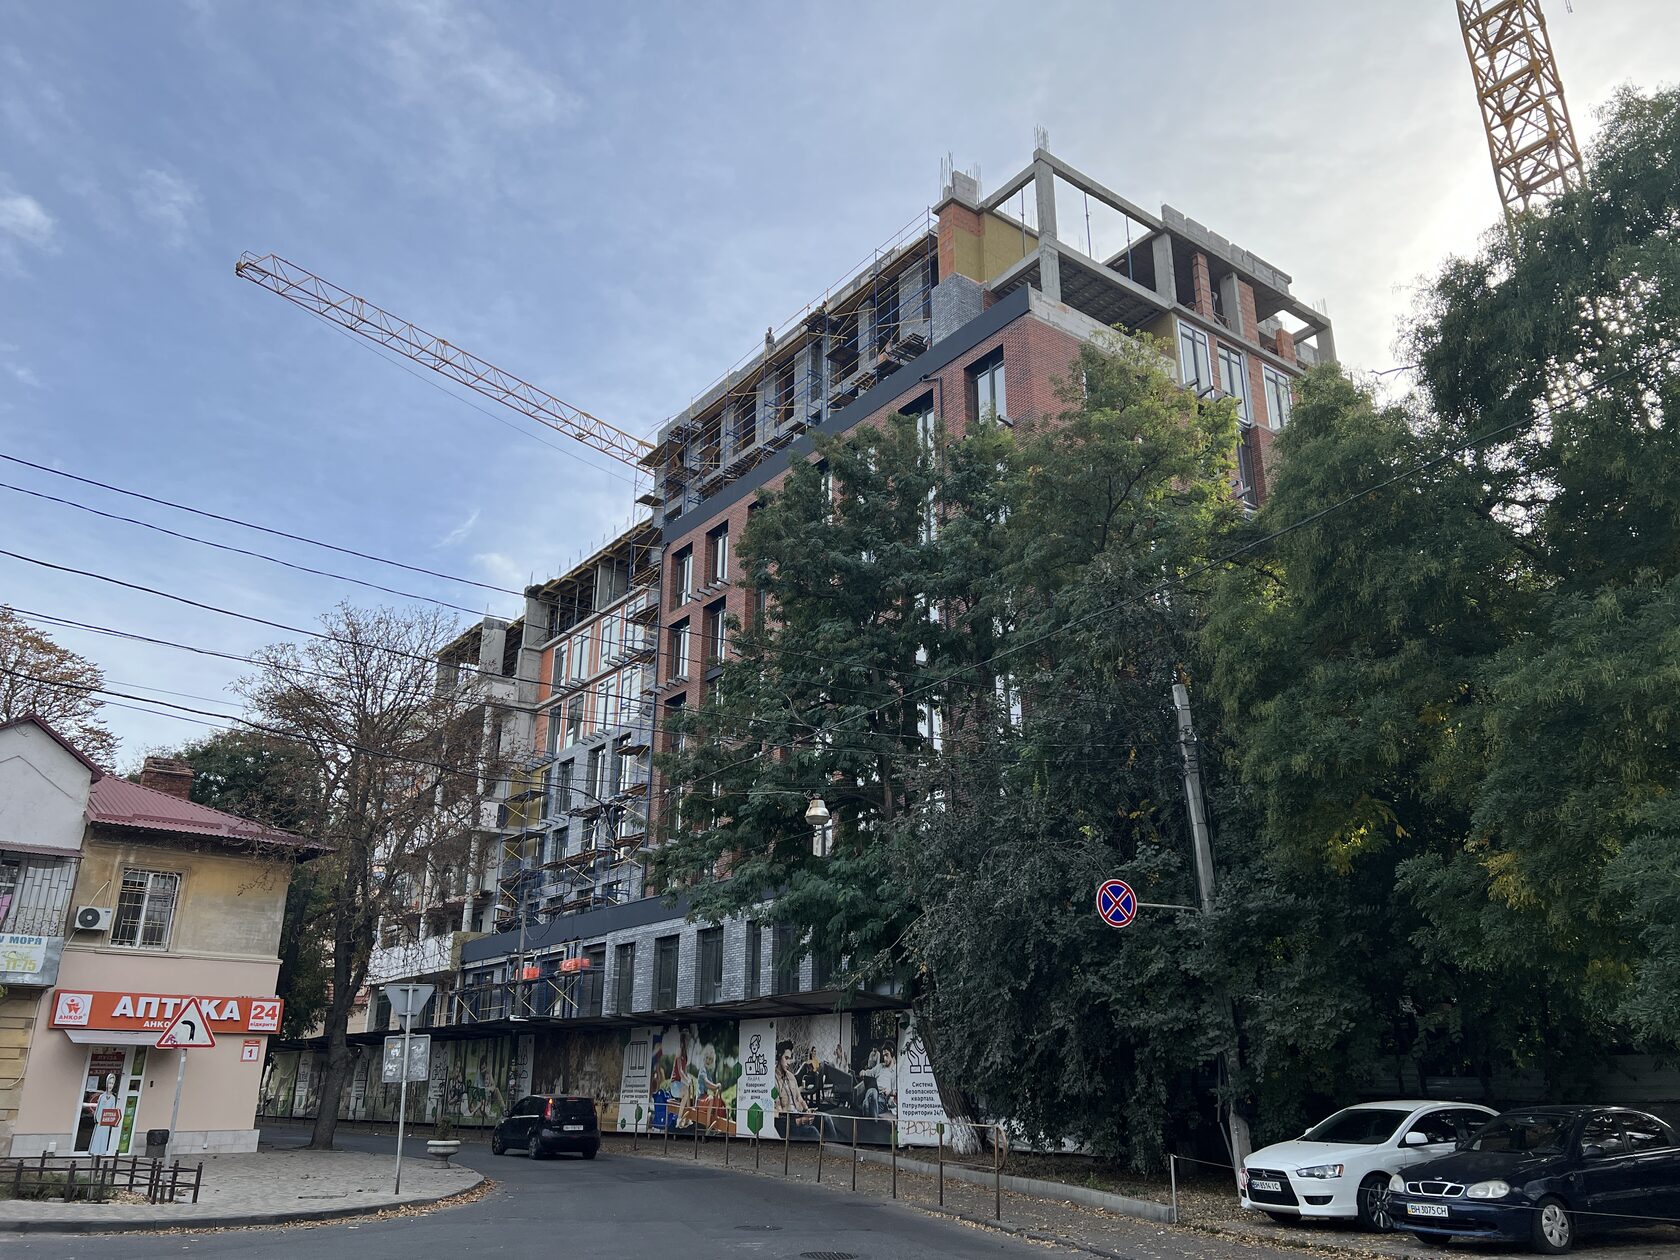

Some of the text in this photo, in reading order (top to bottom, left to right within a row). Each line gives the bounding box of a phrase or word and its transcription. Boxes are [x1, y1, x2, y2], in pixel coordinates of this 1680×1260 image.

[9, 936, 42, 945] МОРЯ
[111, 995, 240, 1021] АПТКА
[251, 1004, 277, 1020] 24
[247, 1048, 253, 1058] 1
[1421, 1206, 1436, 1214] 3075
[1436, 1207, 1447, 1215] CH
